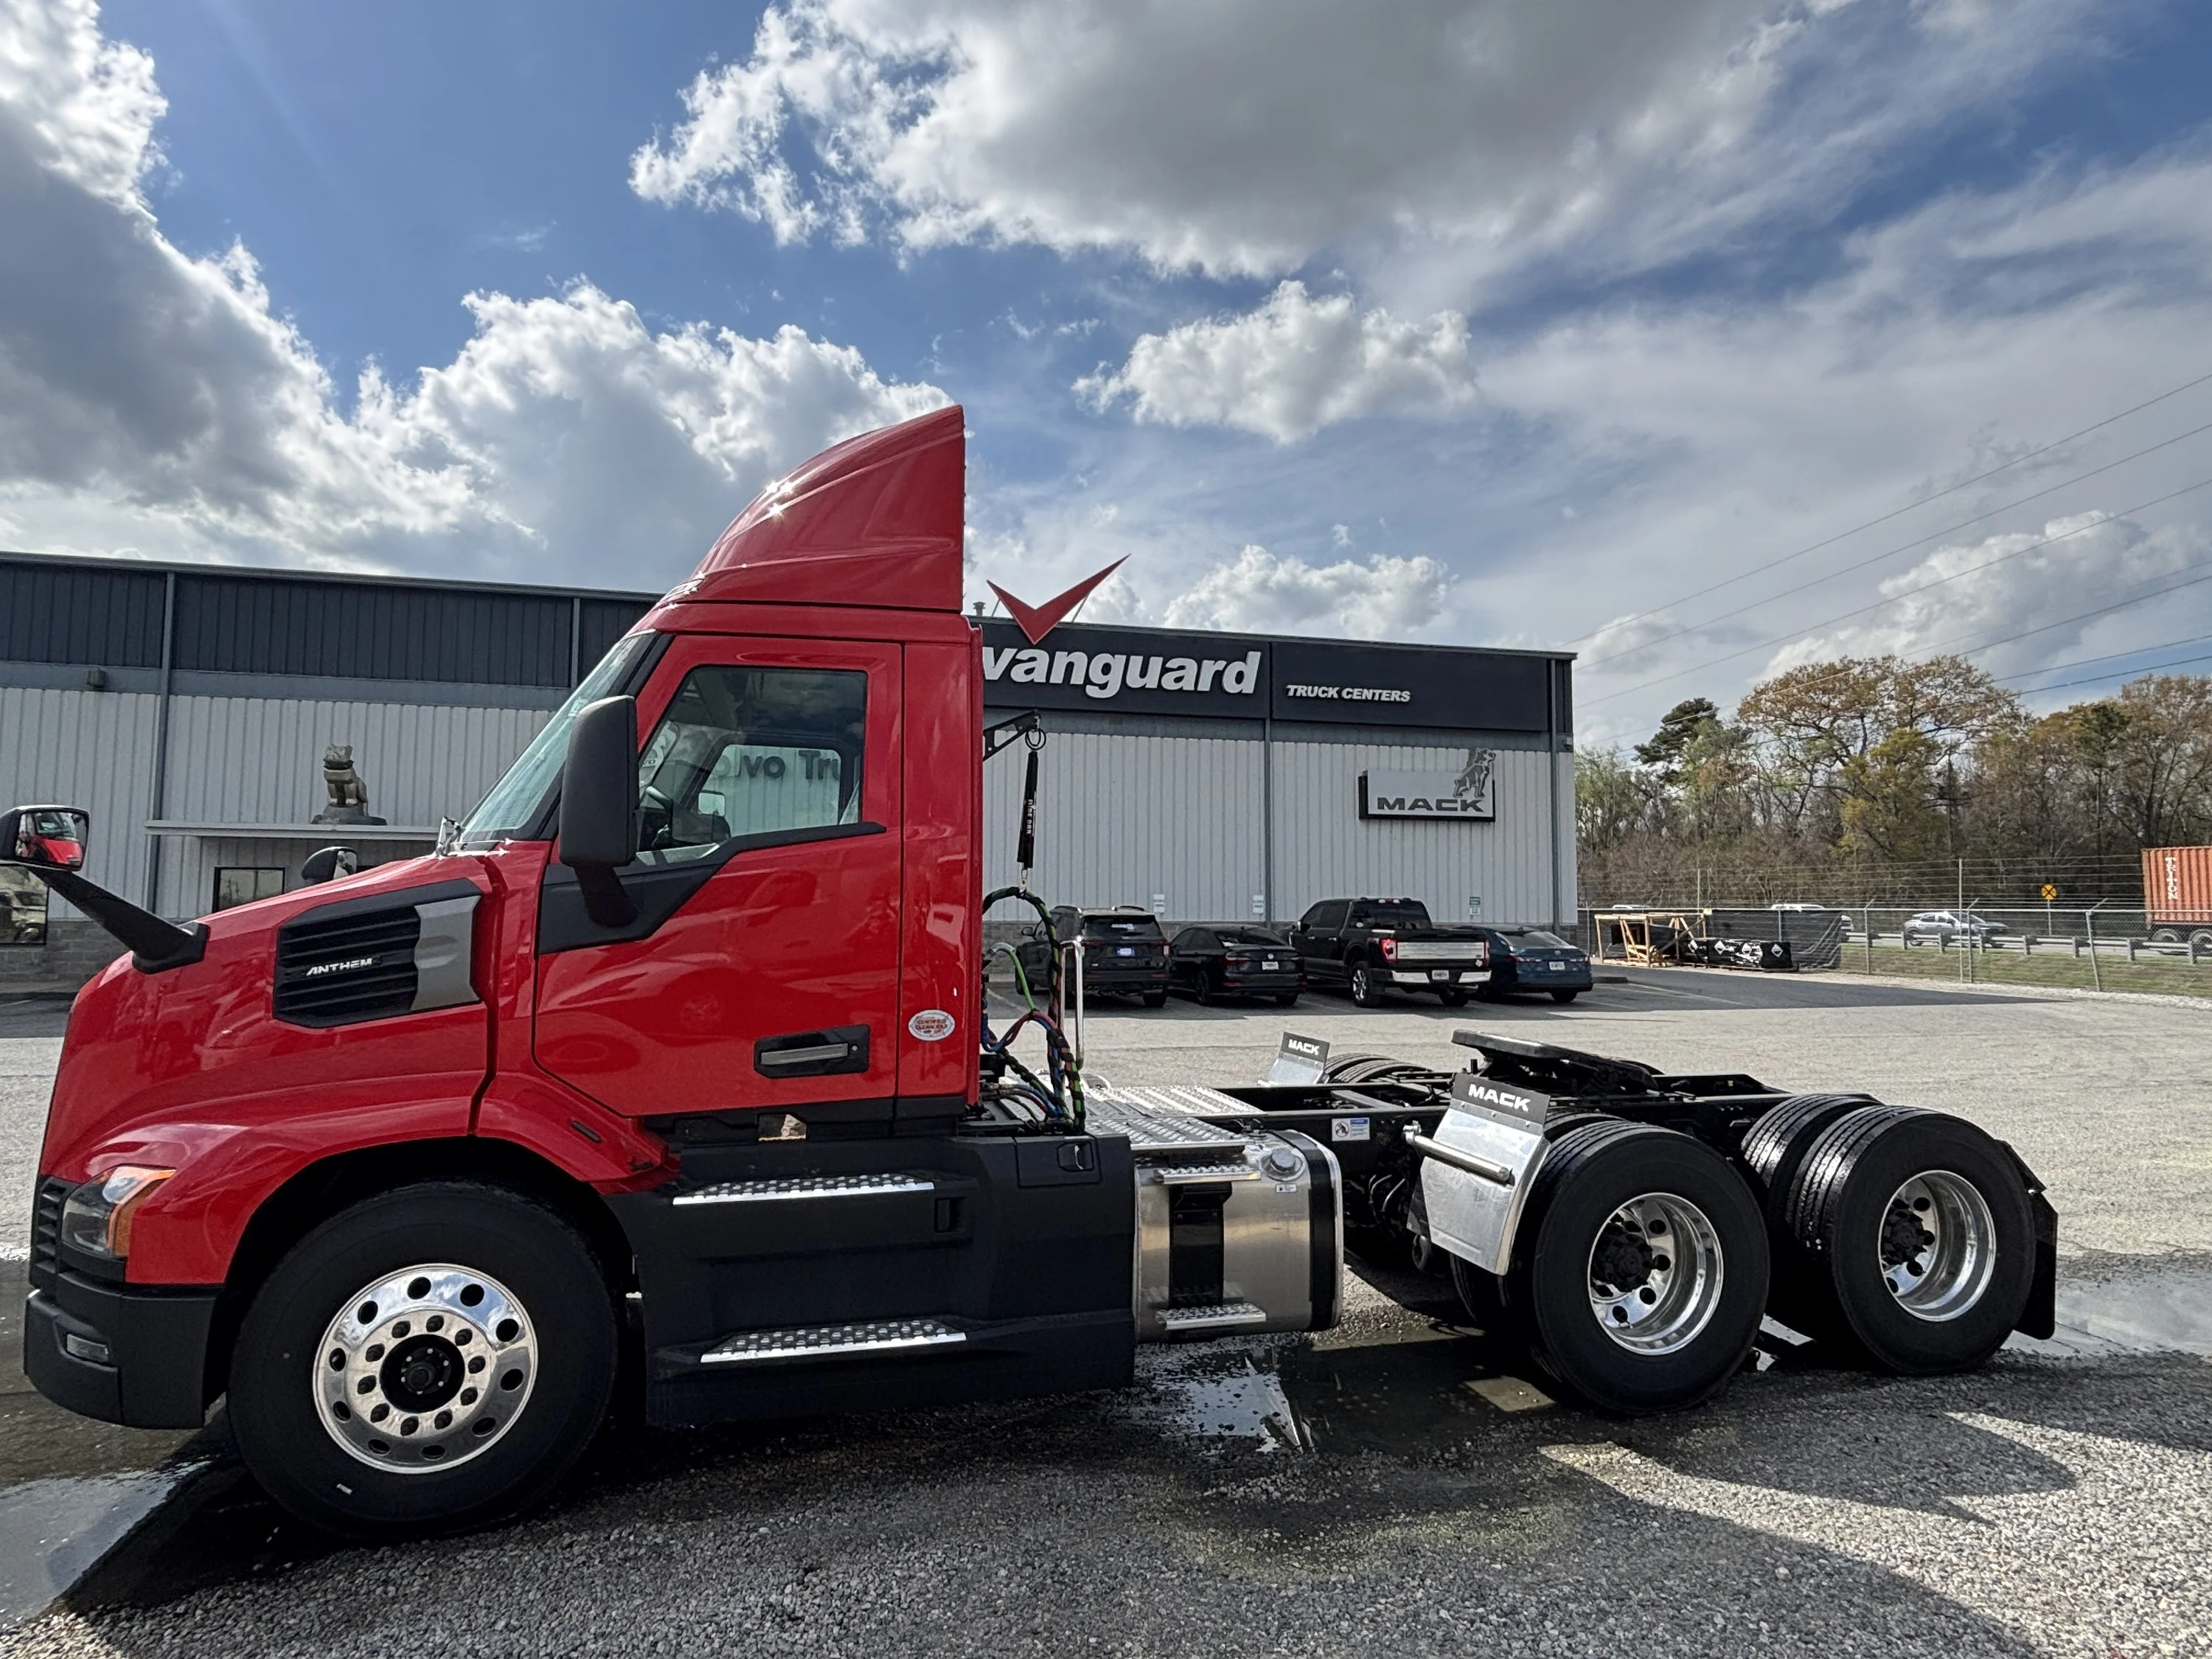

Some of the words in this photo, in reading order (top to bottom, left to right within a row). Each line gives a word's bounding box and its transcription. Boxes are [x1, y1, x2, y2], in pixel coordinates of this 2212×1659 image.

[982, 647, 1262, 699] vanguard
[1286, 684, 1340, 698] TRUCK
[1341, 687, 1411, 703] CENTERS
[1377, 796, 1484, 813] MACK
[305, 958, 372, 976] ANTHEM
[1288, 1039, 1320, 1056] MACK
[1468, 1083, 1531, 1112] MACK
